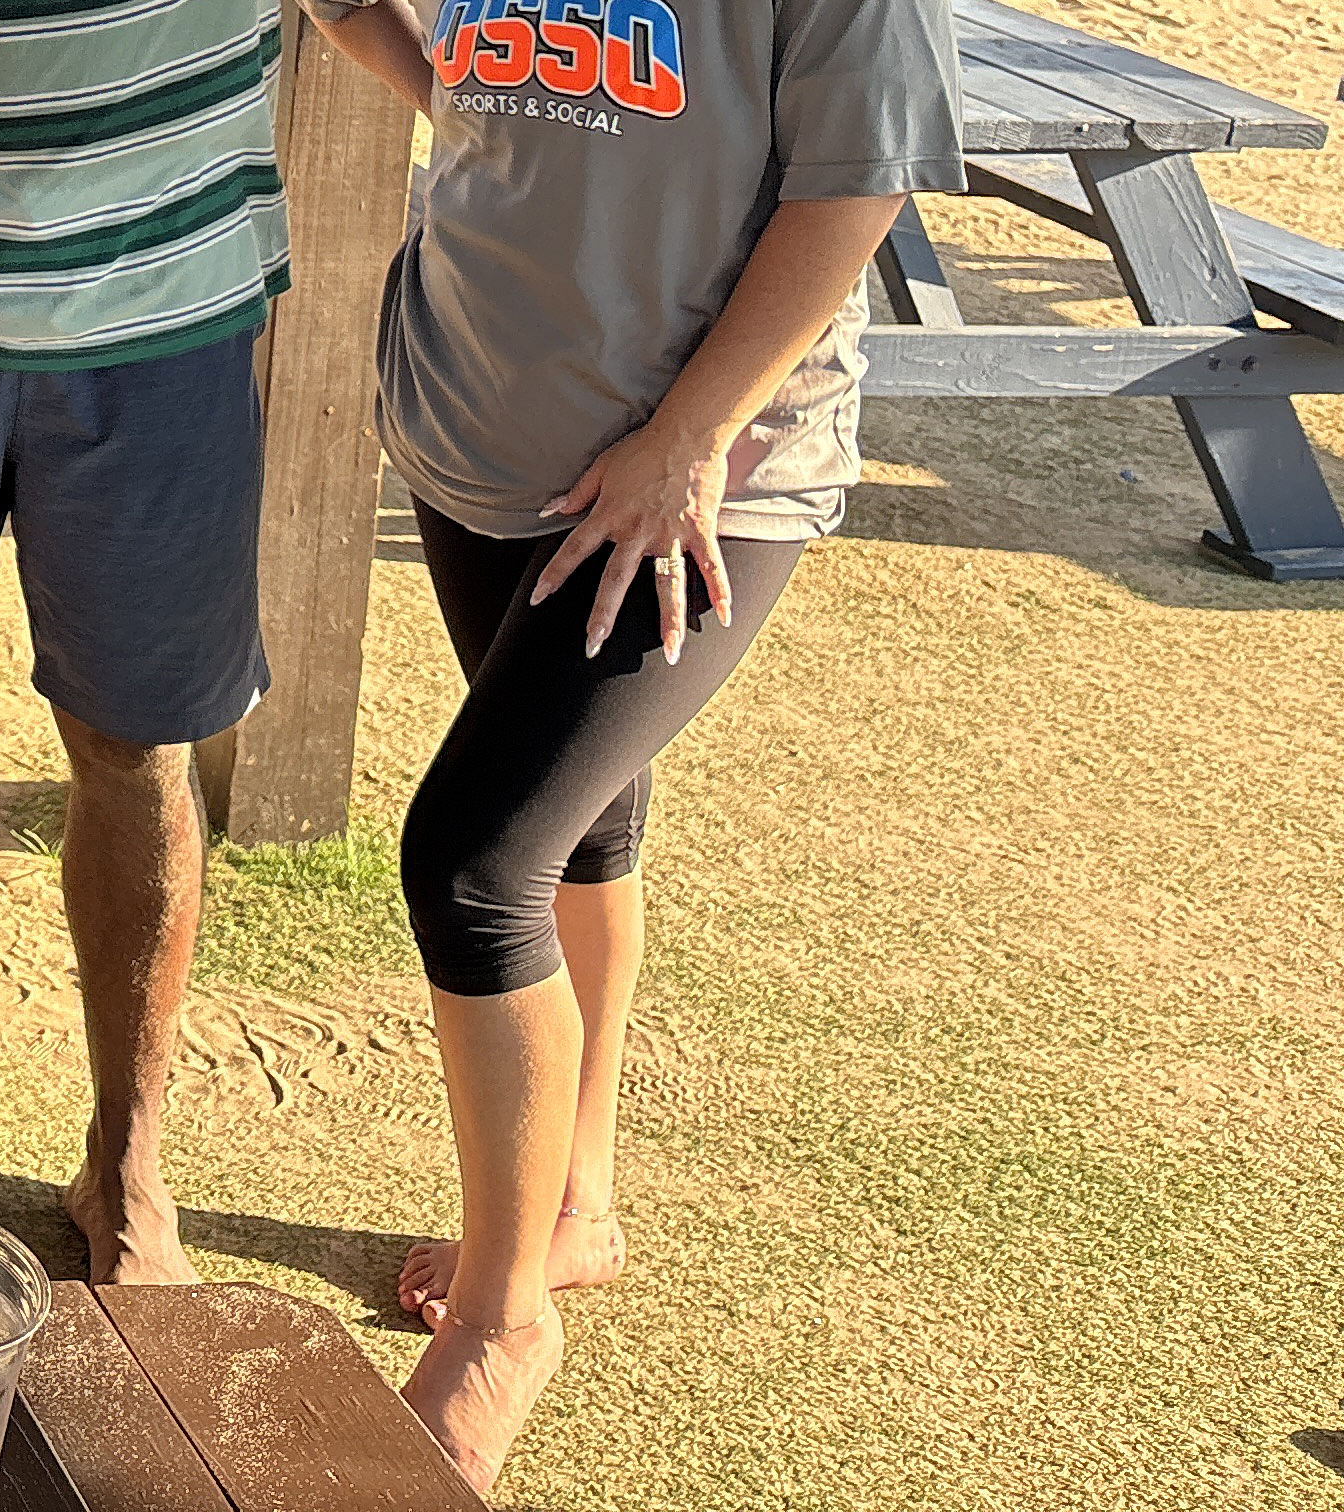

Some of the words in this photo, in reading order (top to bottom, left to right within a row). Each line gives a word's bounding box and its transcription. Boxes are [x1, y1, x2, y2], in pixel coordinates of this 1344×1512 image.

[452, 92, 519, 115] SPORTS
[525, 97, 541, 118] &
[544, 99, 623, 137] SOCIAL
